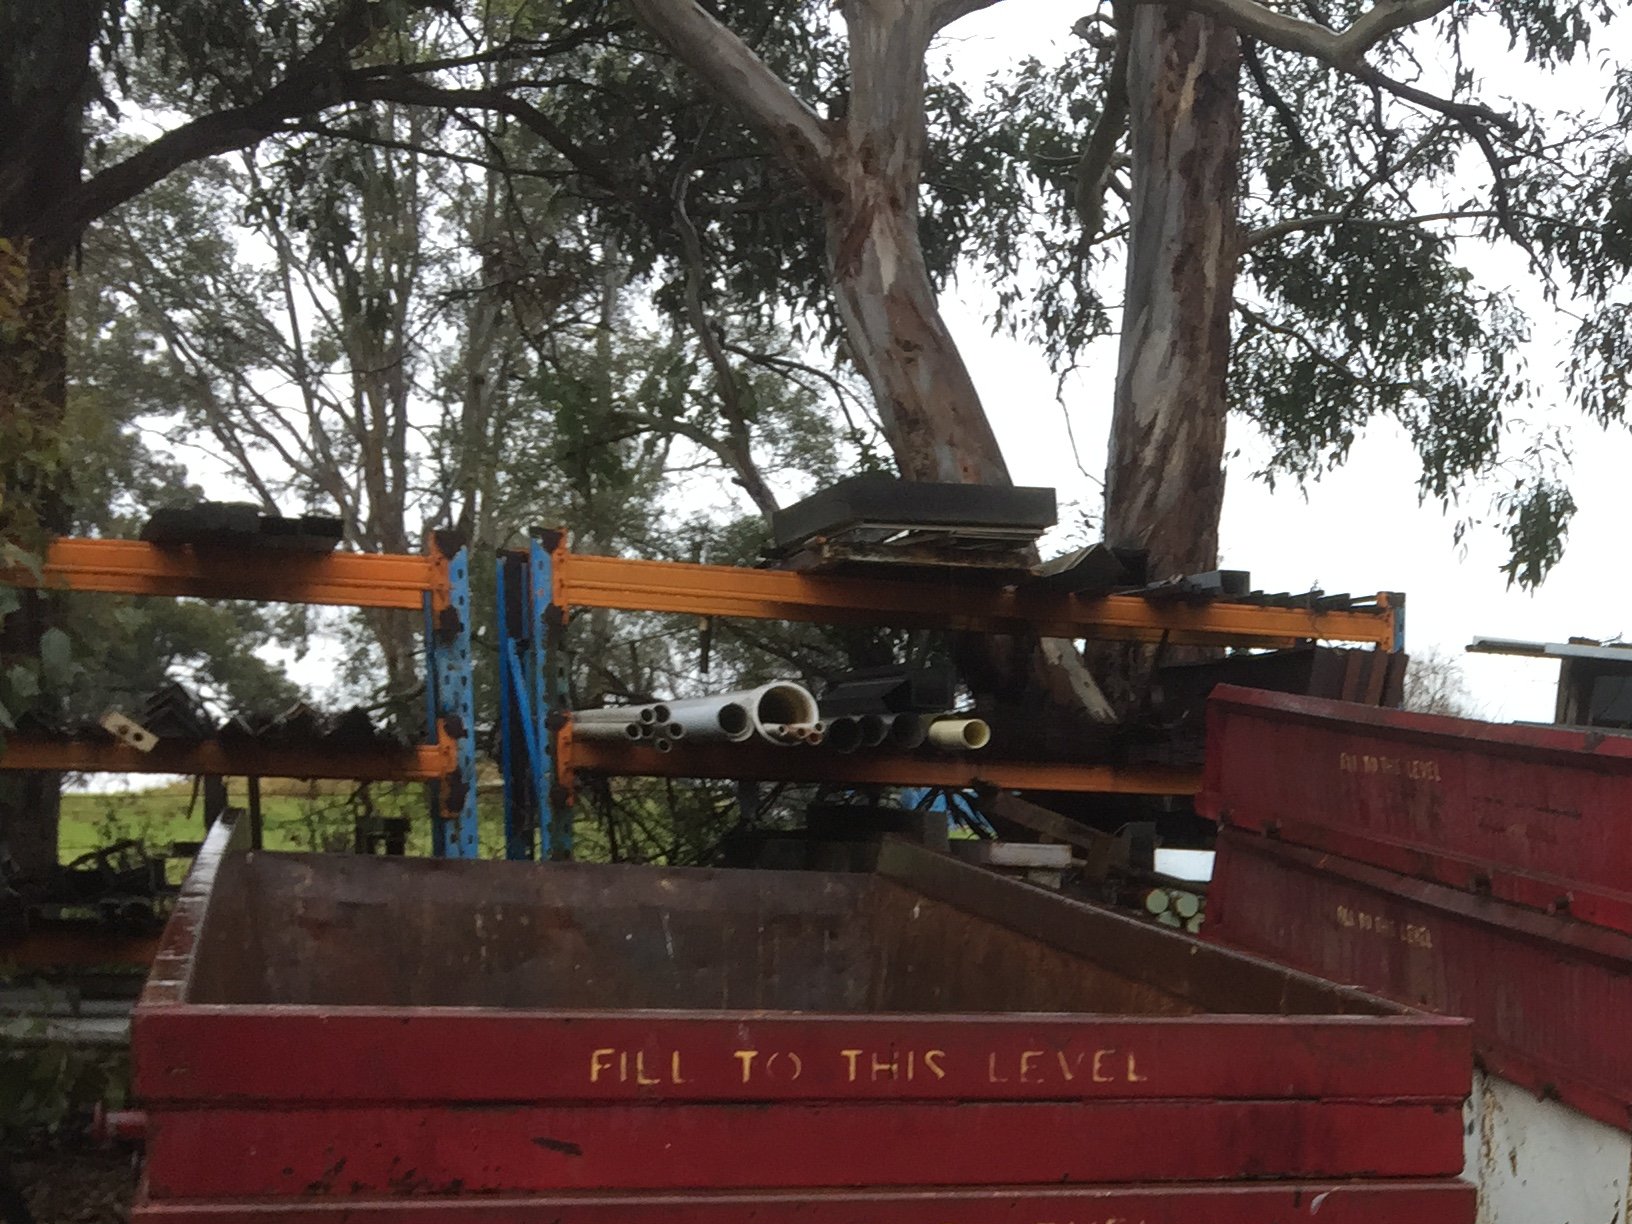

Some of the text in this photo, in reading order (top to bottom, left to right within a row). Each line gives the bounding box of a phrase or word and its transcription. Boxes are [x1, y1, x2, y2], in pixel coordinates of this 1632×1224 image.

[589, 1047, 1149, 1085] FILL TO THIS LEVEL
